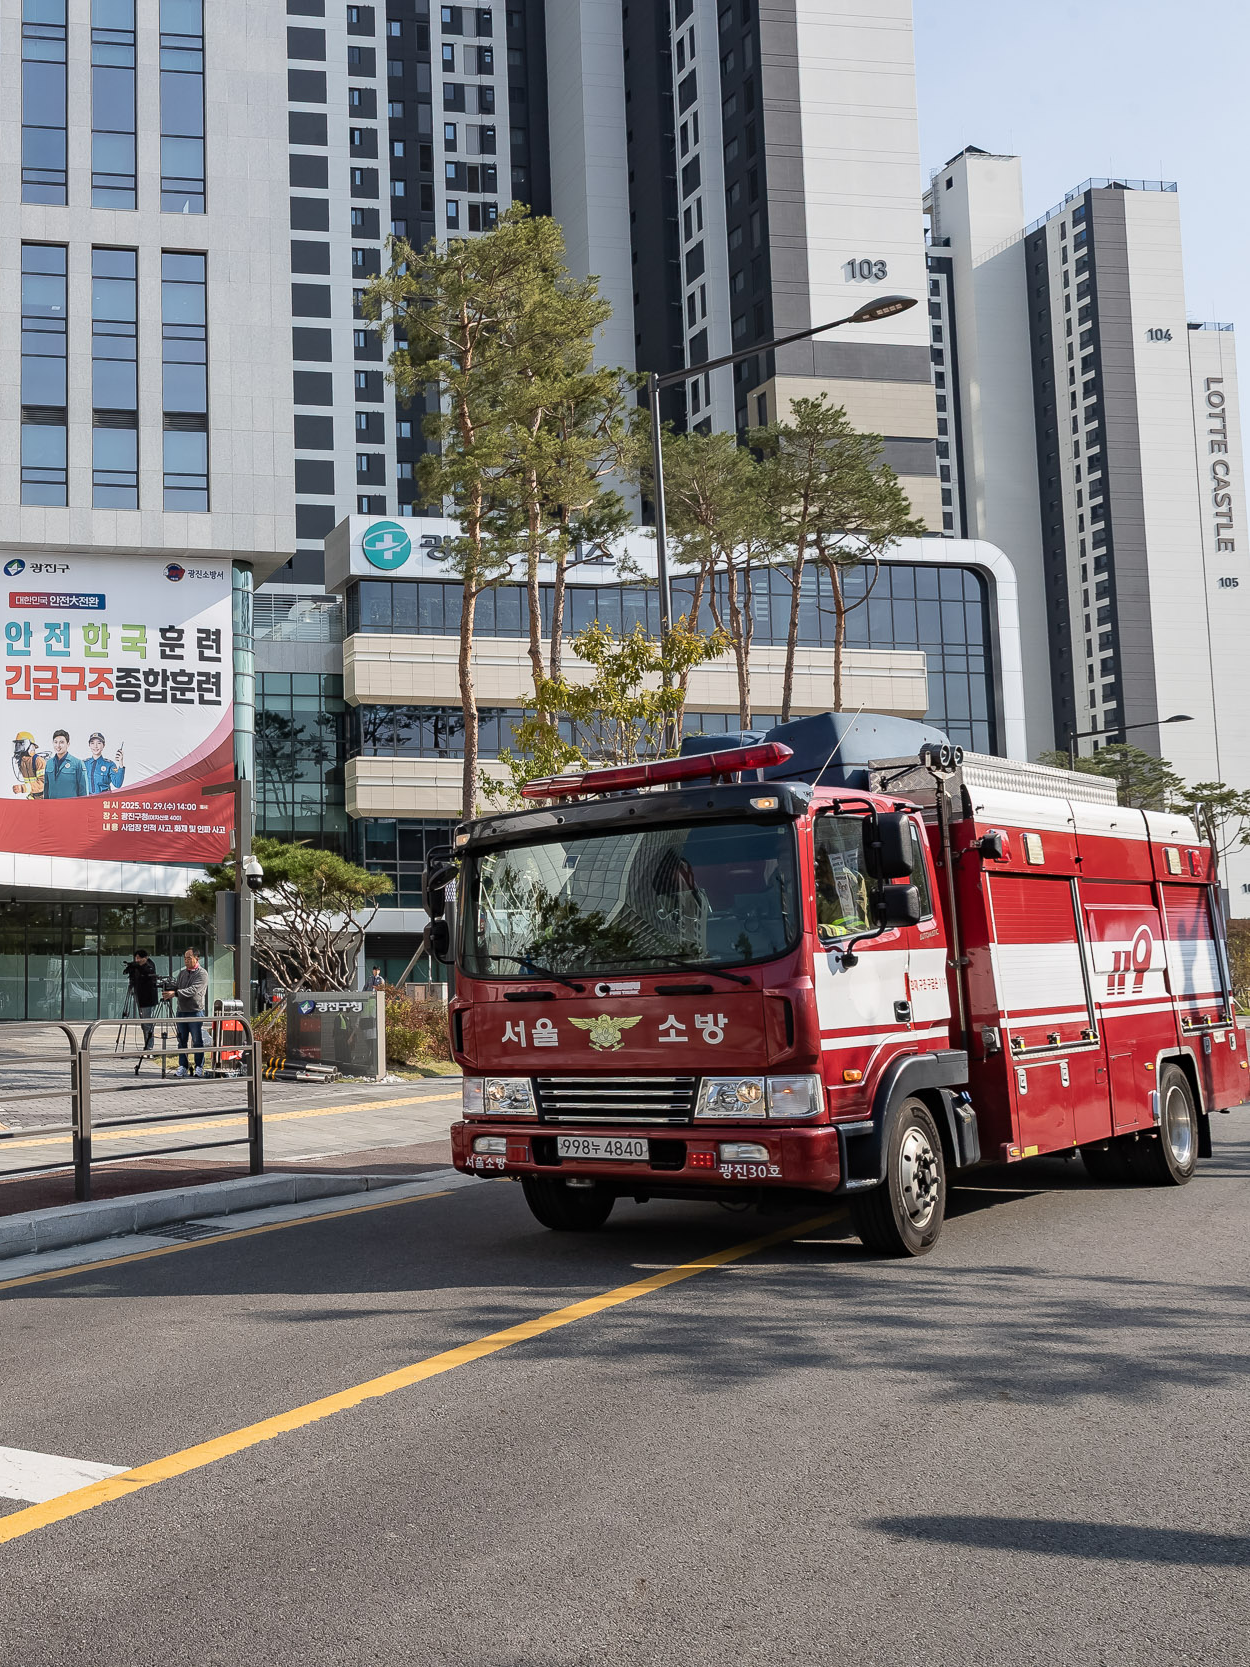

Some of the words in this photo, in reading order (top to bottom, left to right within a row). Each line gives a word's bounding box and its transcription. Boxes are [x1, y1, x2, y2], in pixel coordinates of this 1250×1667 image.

[847, 258, 888, 281] 103
[1148, 328, 1172, 342] 104
[1206, 377, 1228, 454] LOTTE
[1212, 459, 1236, 552] CASTLE
[30, 563, 70, 573] 광진구
[187, 569, 223, 580] 광진소방서
[1219, 577, 1239, 588] 105
[15, 596, 48, 605] 대한민국
[50, 596, 99, 607] 안전大전환
[5, 665, 222, 706] 긴급구조종합훈련
[121, 802, 141, 810] 2025.
[142, 802, 152, 810] 10.
[177, 803, 196, 811] 14:00
[121, 823, 142, 832] 사업장
[212, 825, 226, 834] 사고
[315, 1001, 363, 1013] 광진구청
[502, 1017, 559, 1047] 서울
[658, 1013, 729, 1045] 소방
[563, 1139, 600, 1155] 998누
[604, 1141, 643, 1157] 4840
[465, 1156, 506, 1171] 서울소방
[718, 1163, 783, 1180] 광진30호
